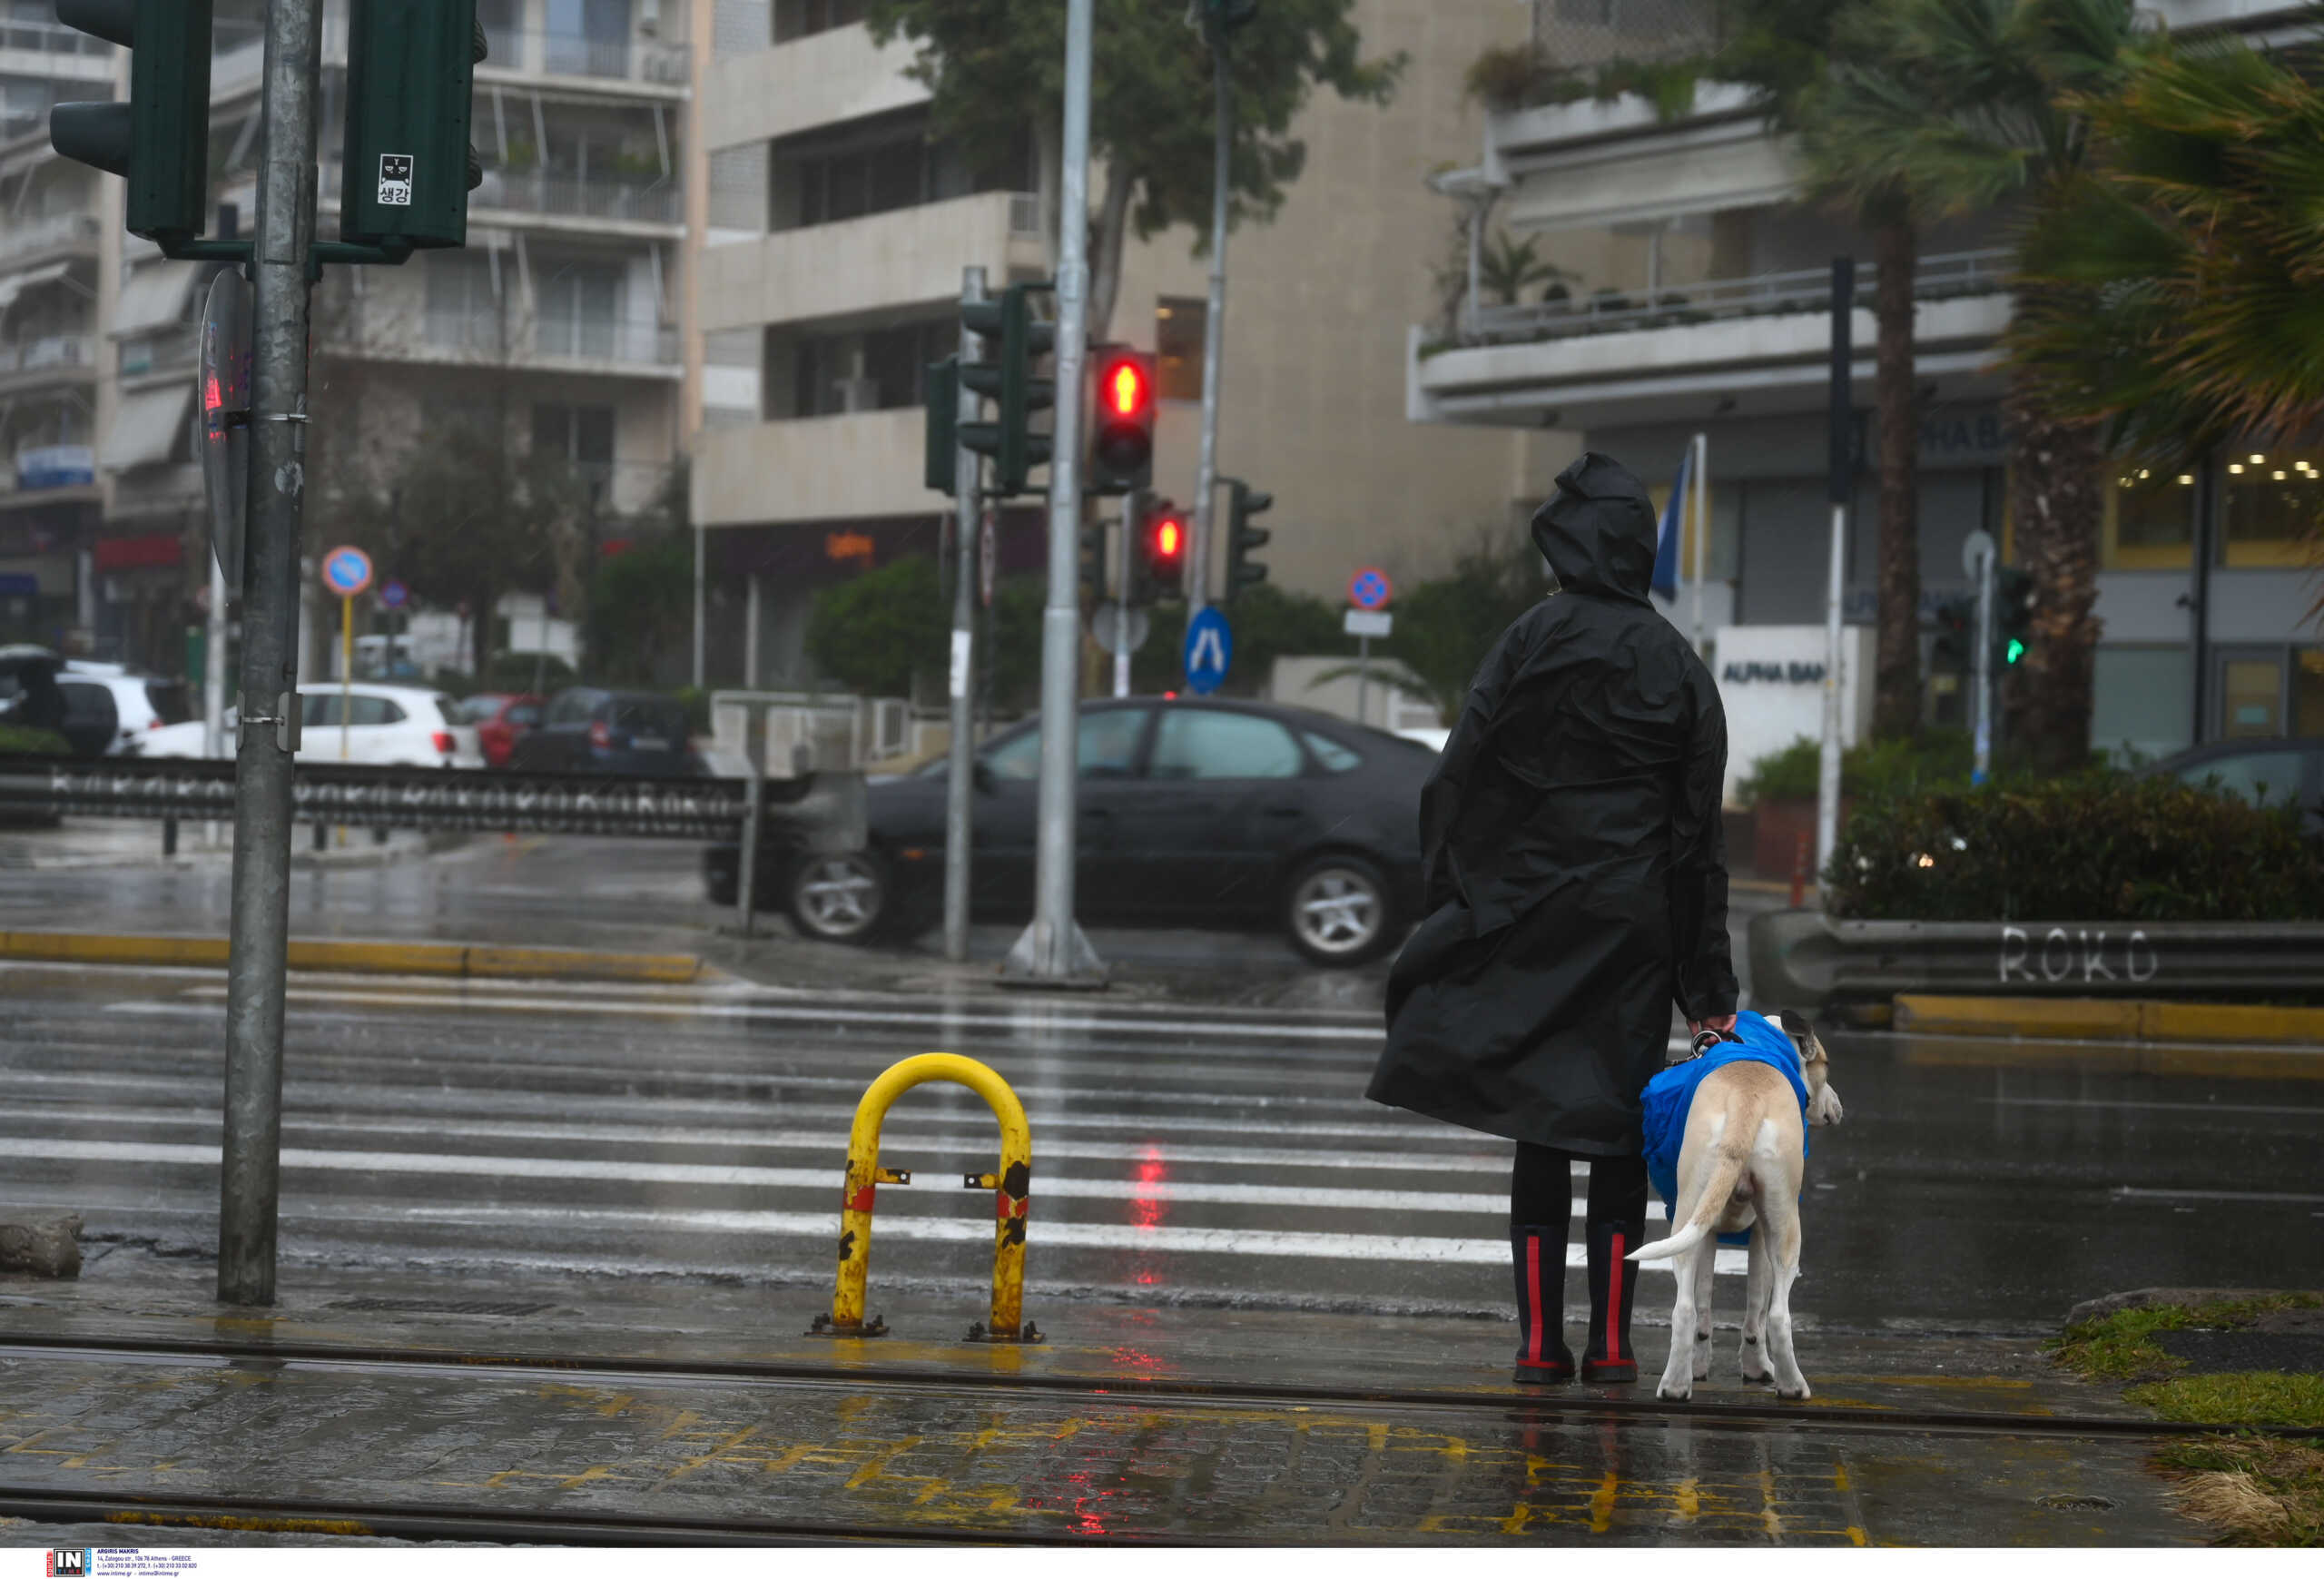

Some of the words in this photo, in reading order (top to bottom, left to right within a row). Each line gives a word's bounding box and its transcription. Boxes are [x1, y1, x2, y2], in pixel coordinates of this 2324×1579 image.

[379, 187, 409, 202] 생강
[1724, 662, 1782, 685] ALPHA
[2000, 926, 2158, 982] ROKO
